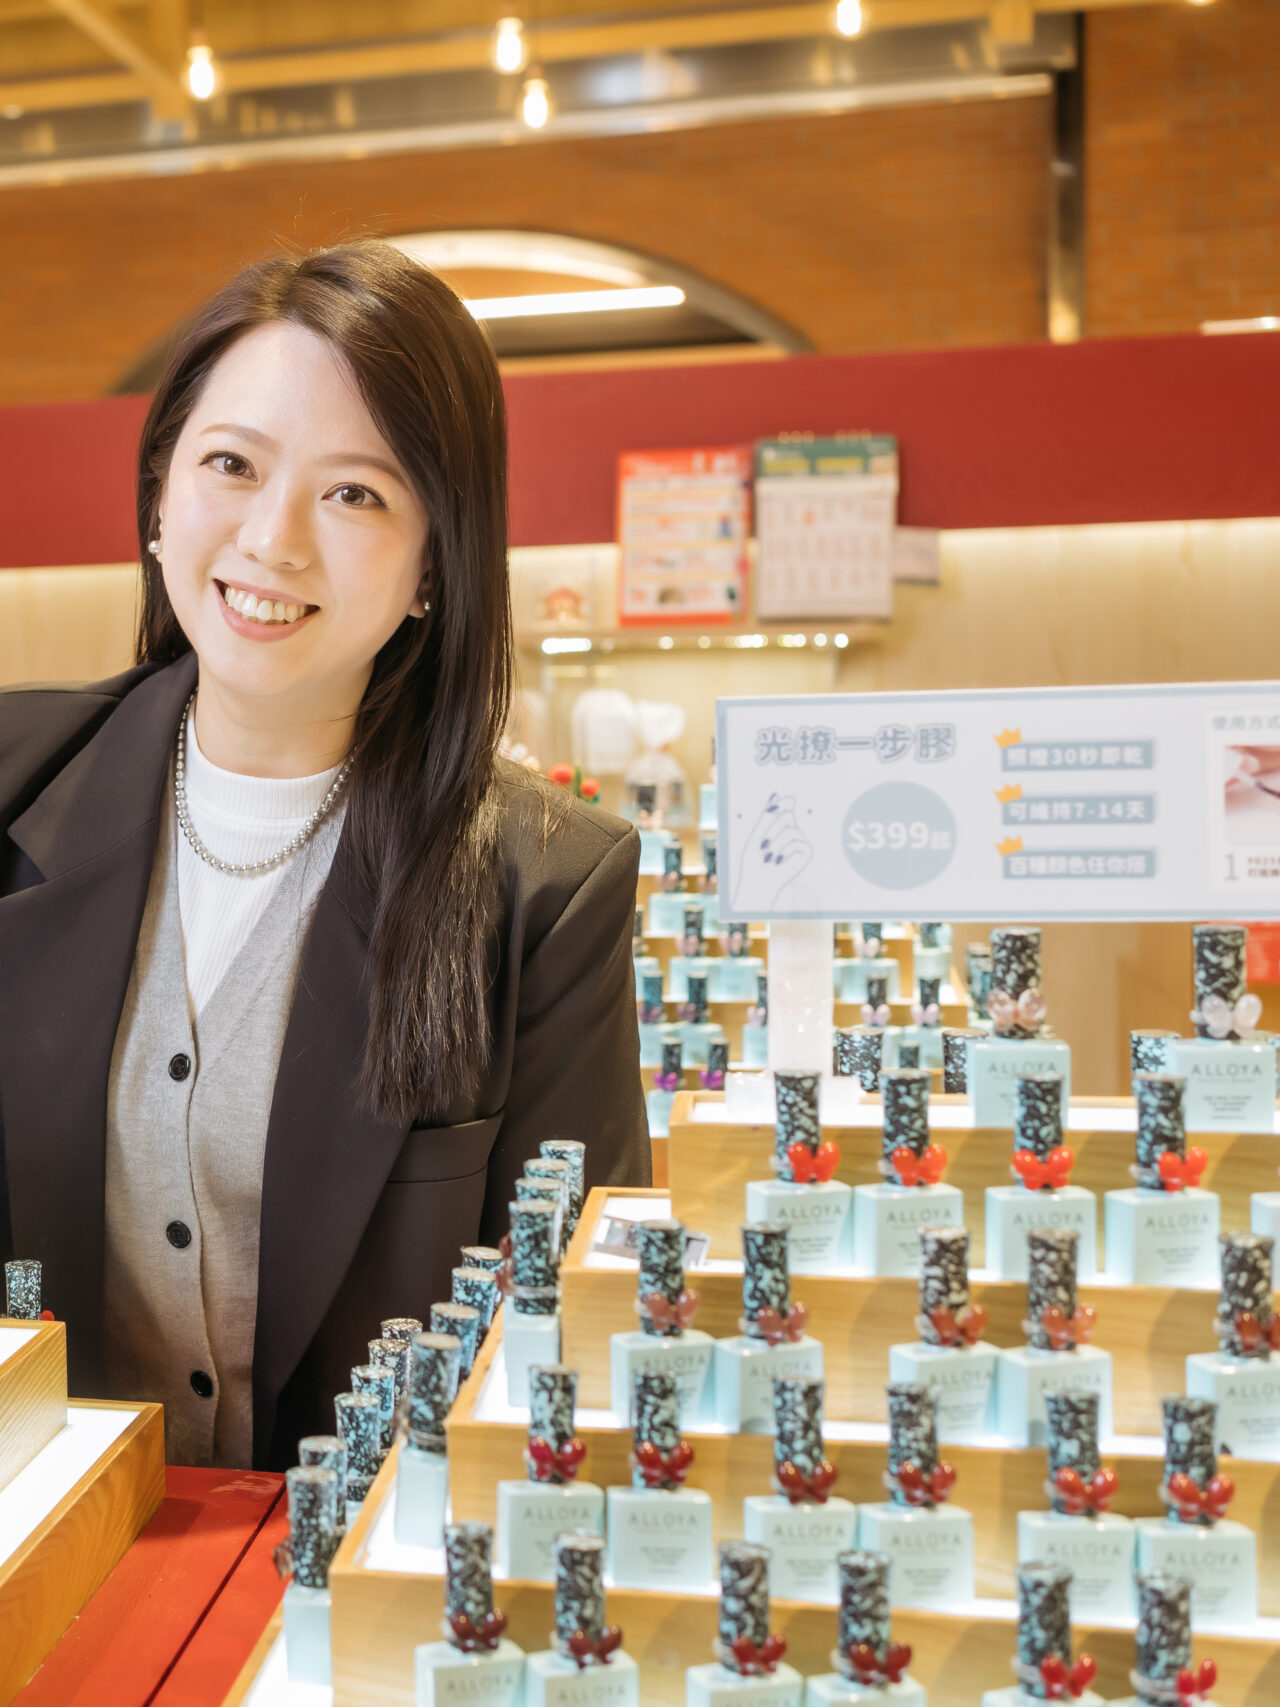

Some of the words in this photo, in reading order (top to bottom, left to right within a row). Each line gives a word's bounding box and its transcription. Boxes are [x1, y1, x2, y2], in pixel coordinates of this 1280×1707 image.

[757, 725, 955, 764] 光撩一步膠
[988, 1061, 1056, 1074] ALLOYA
[1191, 1062, 1263, 1076] ALLOYA
[777, 1205, 843, 1219] ALLOYA
[886, 1208, 952, 1223] ALLOYA
[1013, 1211, 1084, 1225] ALLOYA
[1145, 1213, 1210, 1229] ALLOYA
[1225, 1382, 1280, 1398] ALLO
[524, 1507, 590, 1520] ALLOYA
[629, 1512, 698, 1526] ALLOYA
[774, 1524, 845, 1537] ALLOYA
[890, 1534, 961, 1547] ALLOYA
